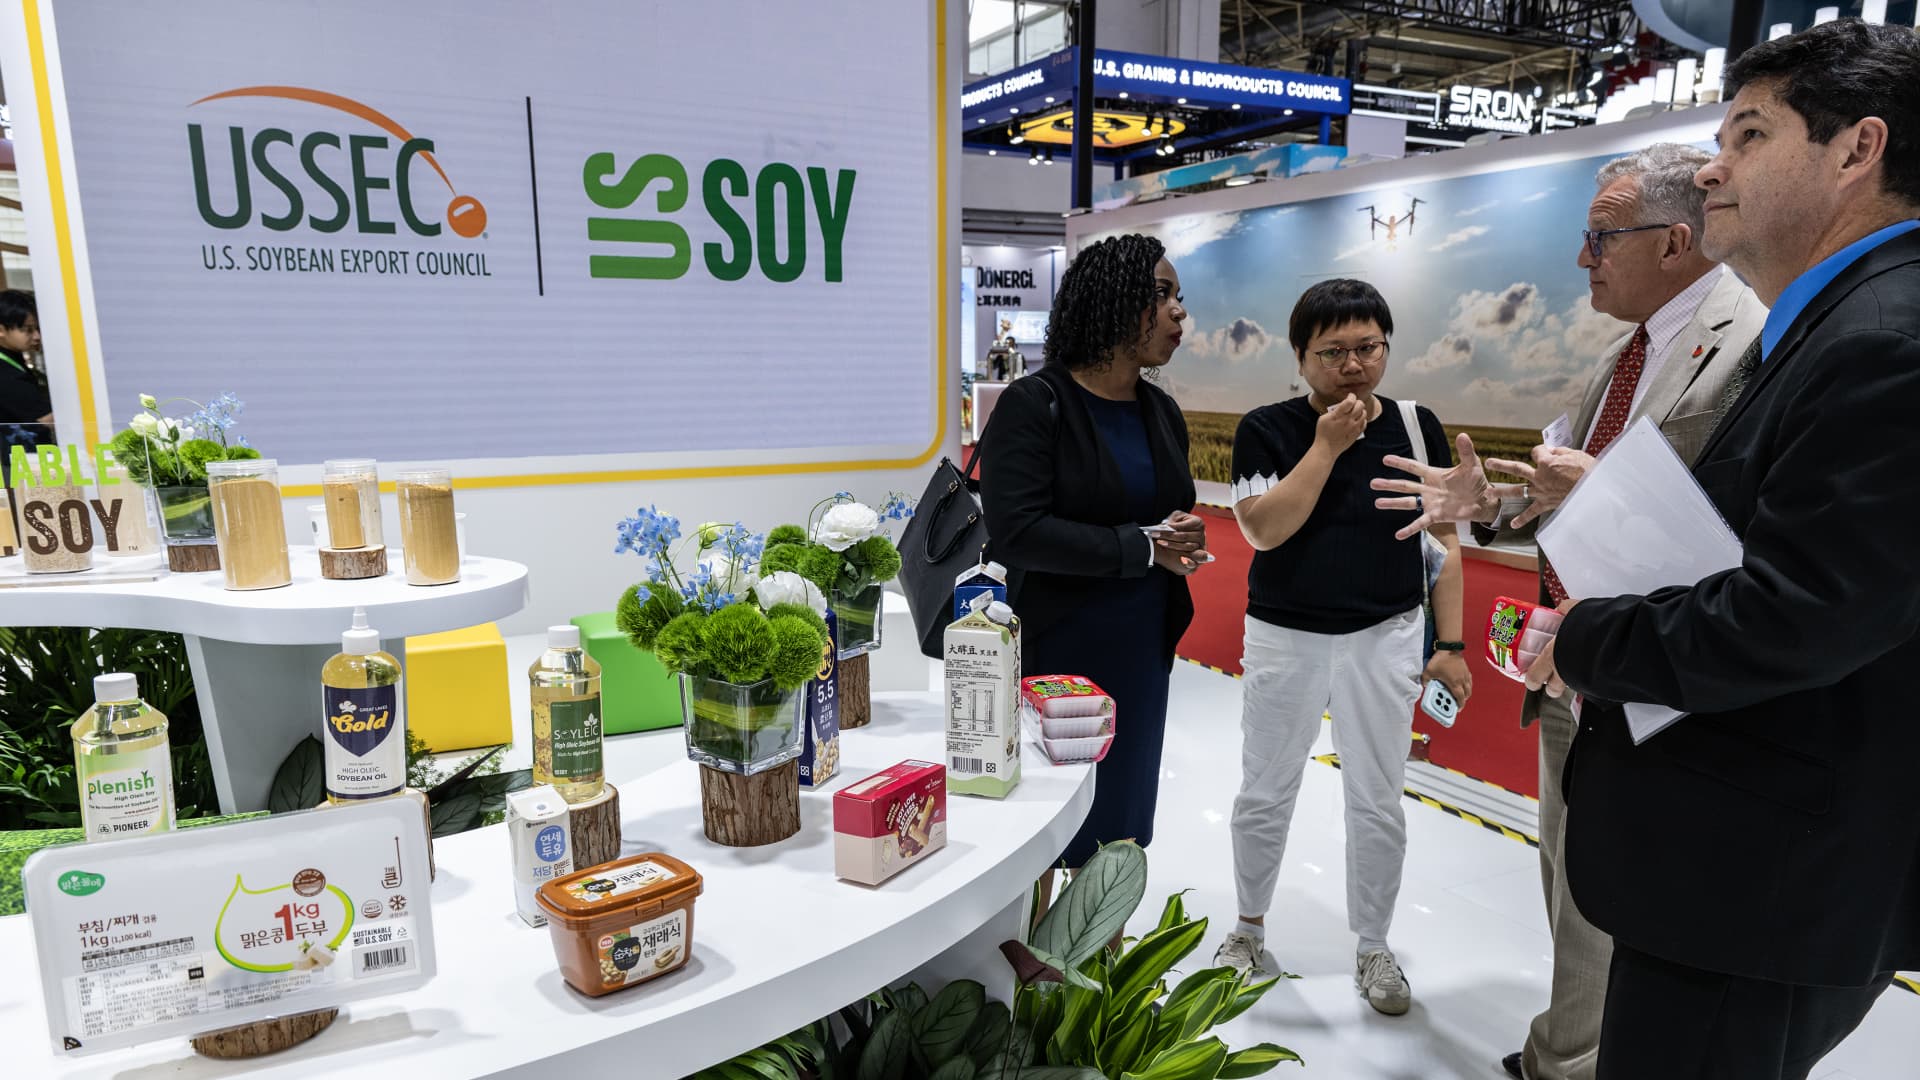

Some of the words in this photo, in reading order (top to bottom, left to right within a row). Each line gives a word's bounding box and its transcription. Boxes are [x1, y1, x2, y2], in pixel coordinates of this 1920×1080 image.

[1003, 69, 1045, 94] COUNCIL
[1094, 59, 1120, 78] U.S.
[1122, 62, 1177, 84] GRAINS
[1179, 69, 1190, 85] &
[1192, 71, 1283, 95] BIOPRODUCTS
[1286, 81, 1342, 101] COUNCIL
[1450, 84, 1533, 121] SRON
[187, 123, 442, 237] USSEC
[583, 152, 691, 280] US
[702, 158, 857, 283] SOY
[202, 245, 241, 272] U.S.
[249, 246, 335, 273] SOYBEAN
[341, 249, 410, 275] EXPORT
[416, 251, 492, 277] COUNCIL
[0, 443, 121, 488] ABLE
[23, 498, 123, 555] SOY
[817, 680, 834, 703] 5.5
[330, 711, 389, 733] Gold
[336, 774, 373, 782] SOYBEAN
[374, 772, 388, 780] OIL
[359, 766, 381, 774] OLEIC
[113, 820, 149, 832] PIONEER
[540, 831, 562, 846] 연세
[541, 844, 562, 857] 두유
[532, 865, 552, 877] 저당
[80, 935, 109, 949] 1kg
[134, 930, 152, 940] kcal)
[295, 920, 329, 939] 두부
[353, 926, 392, 938] SUSTAINABLE
[365, 935, 378, 945] U.S.
[378, 932, 392, 943] SOY
[642, 922, 681, 949] 재래식
